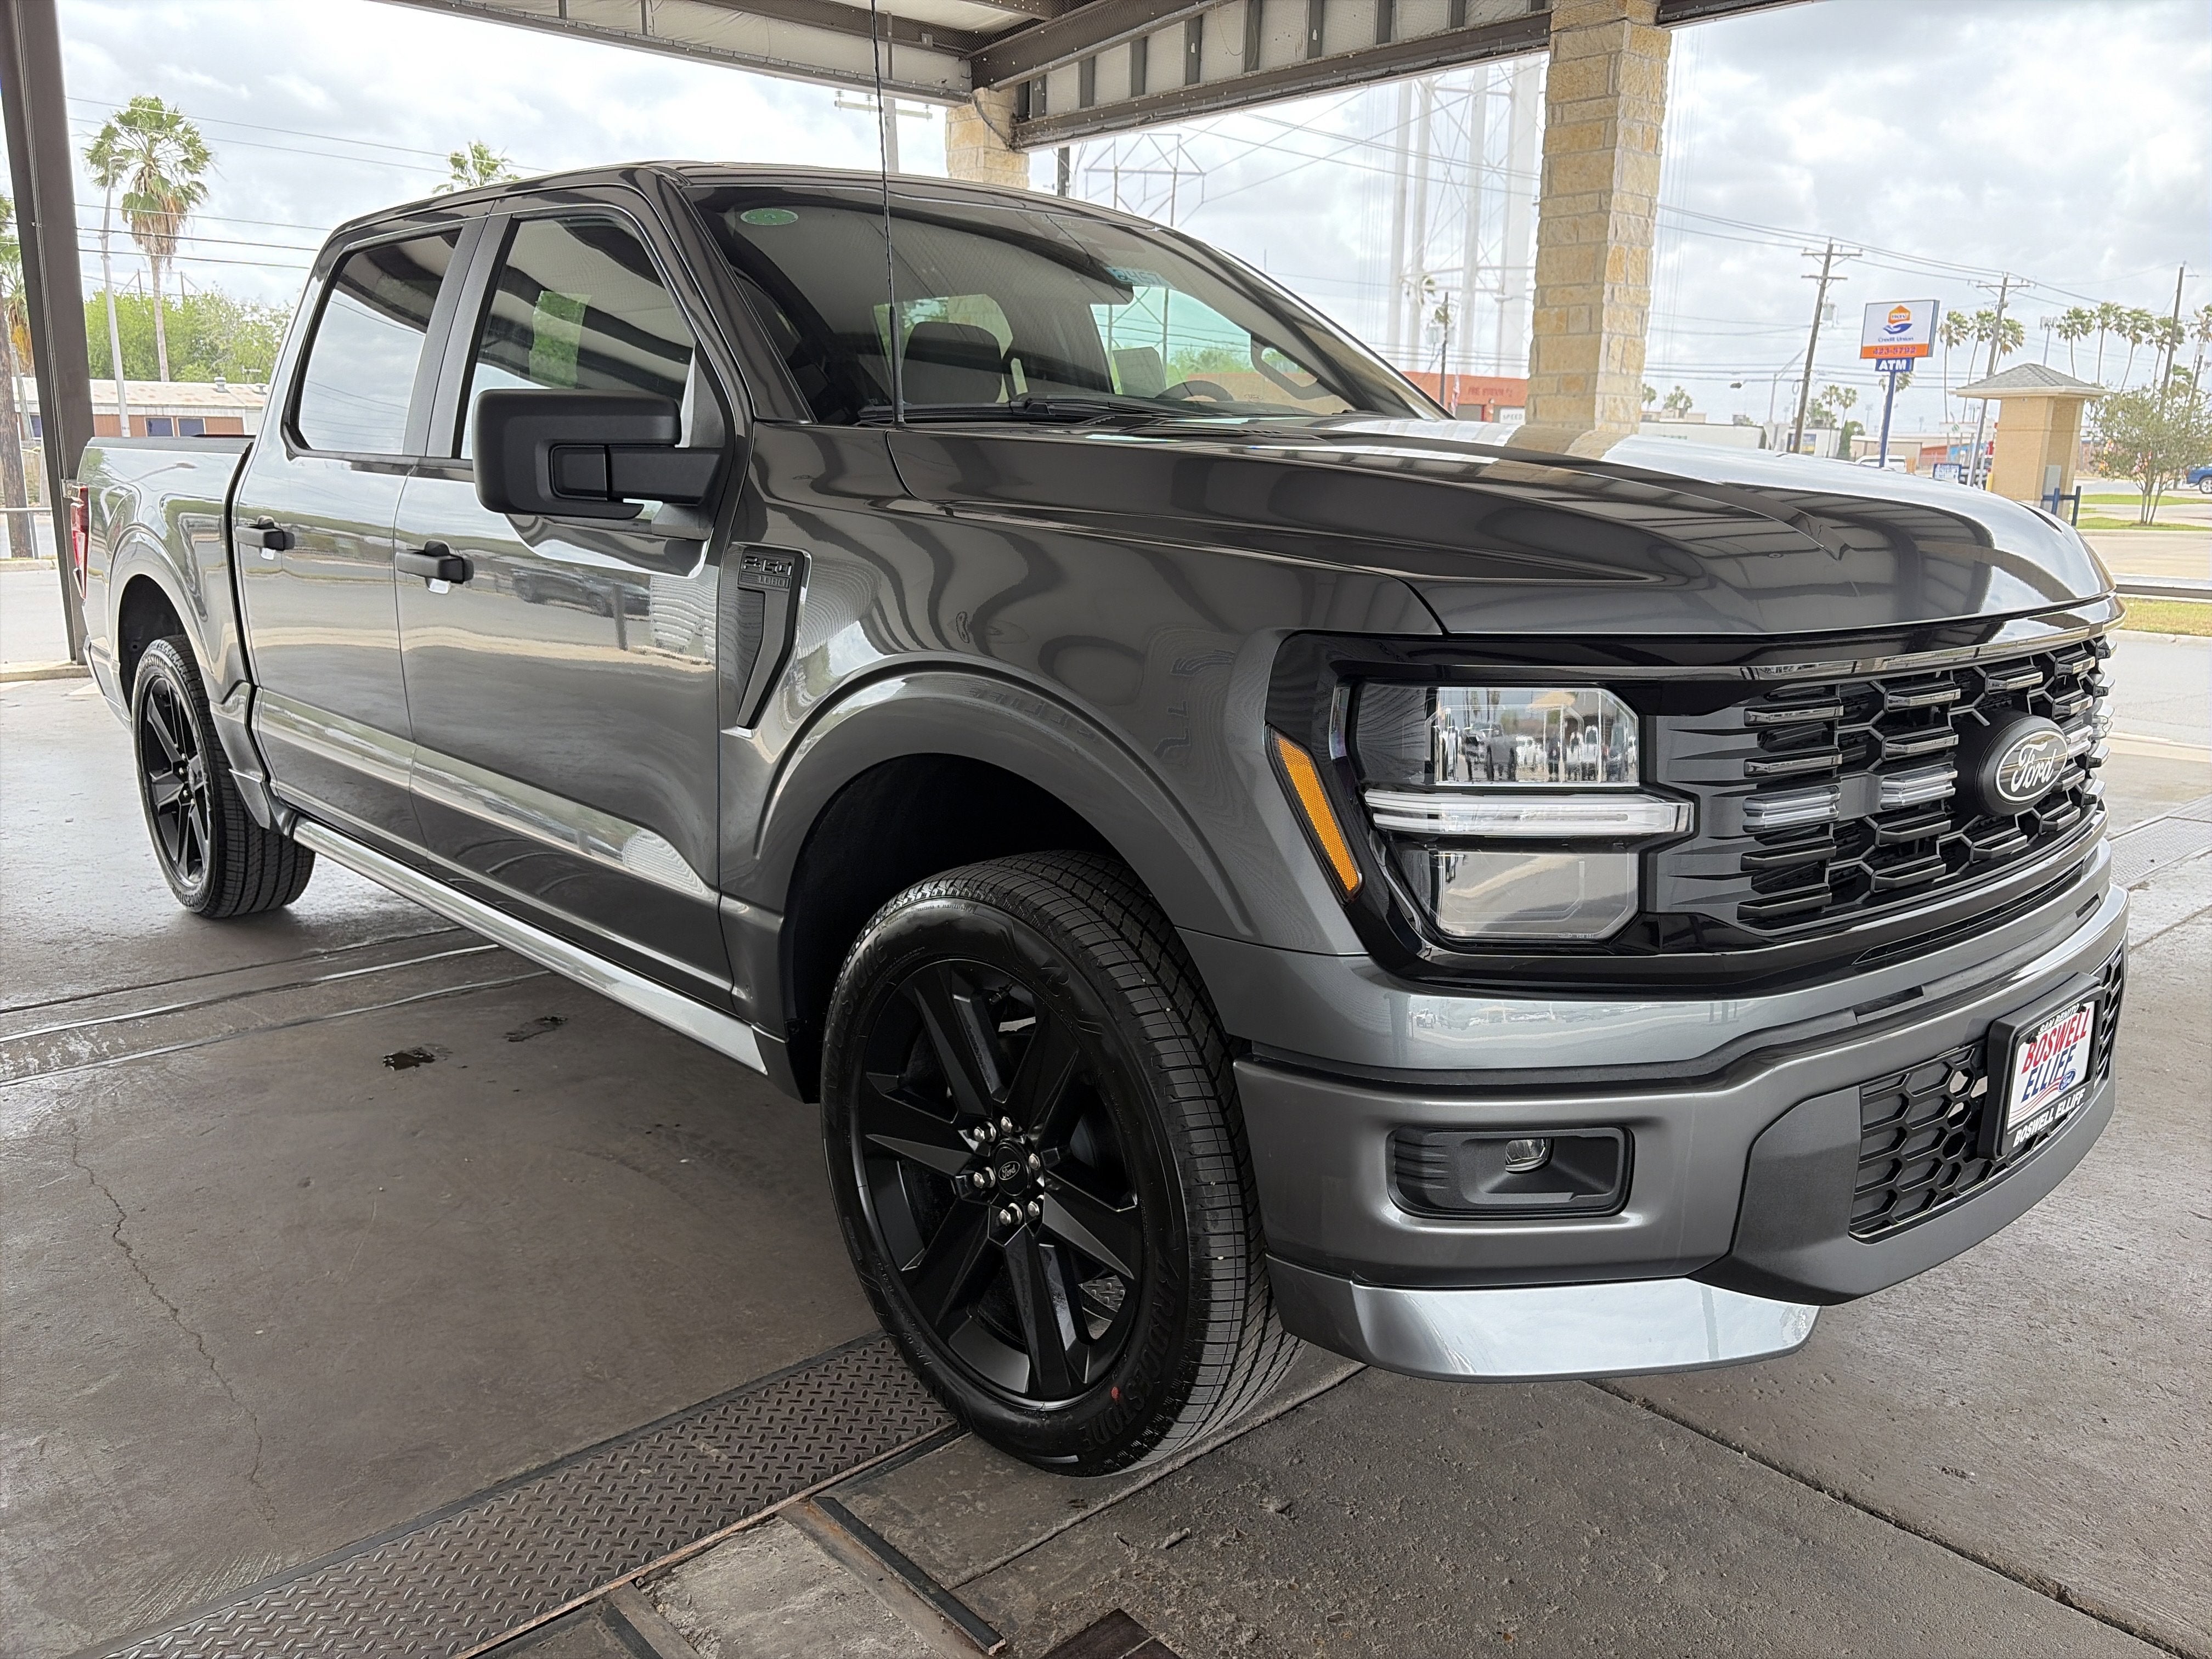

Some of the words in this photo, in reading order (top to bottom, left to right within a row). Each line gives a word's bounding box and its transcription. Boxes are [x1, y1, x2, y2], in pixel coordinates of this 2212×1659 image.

[1878, 359, 1907, 370] ATM
[2011, 741, 2057, 793] Ford
[2021, 1007, 2091, 1075] BOSWELL
[2038, 1018, 2055, 1035] SAN
[2054, 1003, 2080, 1024] BENITO
[2021, 1042, 2078, 1104] ELLIFF
[2012, 1107, 2054, 1148] BOSWELL
[2055, 1088, 2086, 1119] ELLIFF
[1002, 1164, 1016, 1178] Ford
